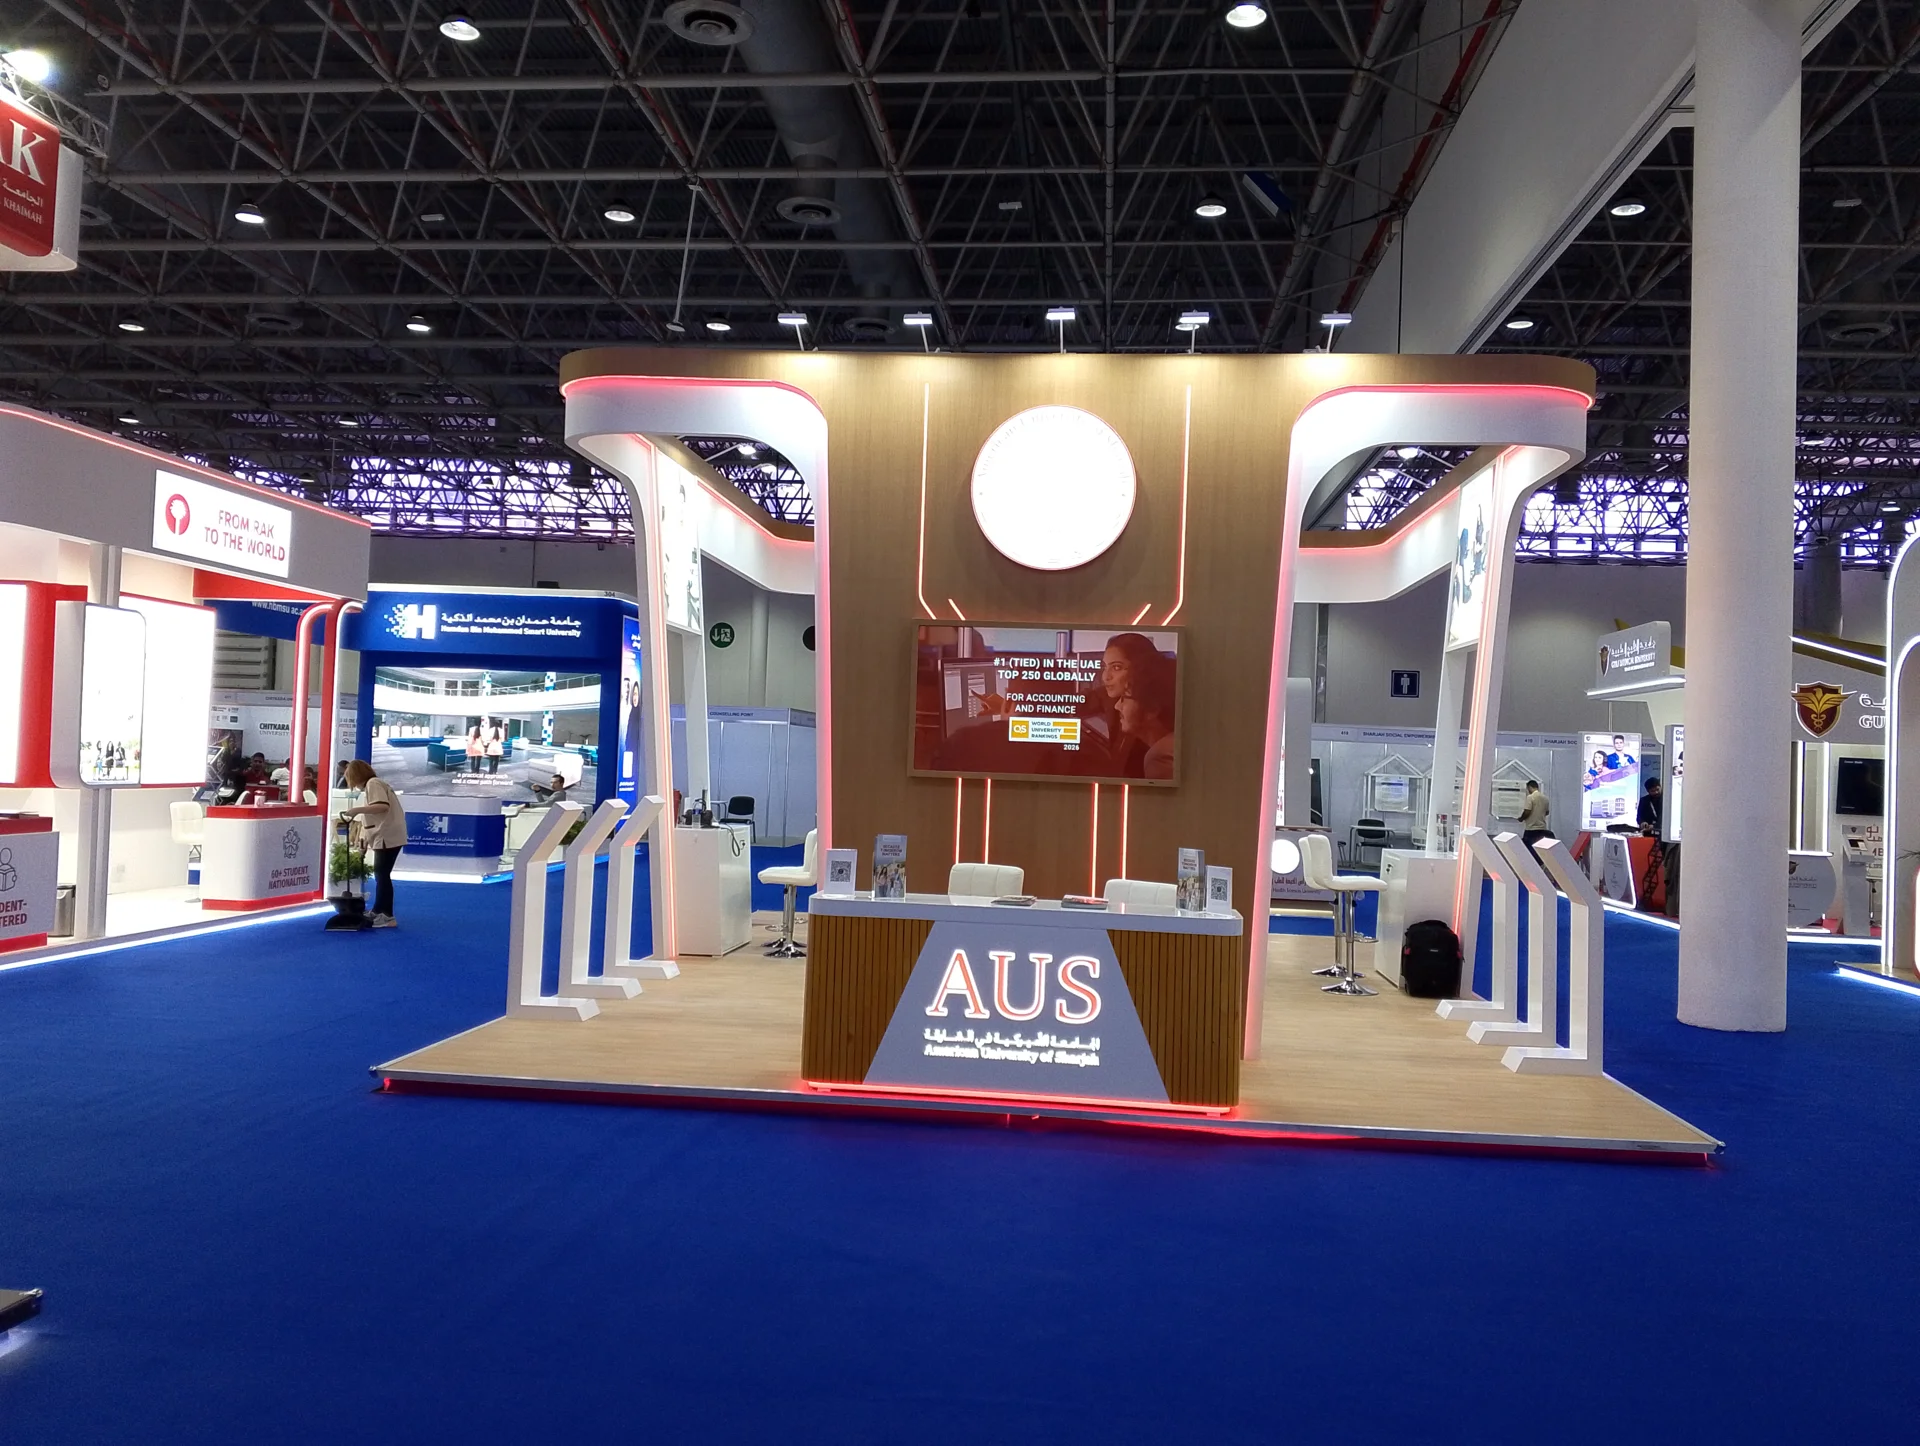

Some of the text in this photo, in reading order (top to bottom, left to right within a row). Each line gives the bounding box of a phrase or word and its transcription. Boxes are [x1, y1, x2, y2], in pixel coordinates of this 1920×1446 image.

[0, 118, 46, 186] K
[3, 196, 42, 224] KHAIMAH
[219, 510, 275, 539] FROM RAK
[205, 527, 286, 562] TO THE WORLD
[441, 612, 581, 628] جامعة حمدان بن محمد الذكية
[546, 629, 581, 638] University
[994, 657, 1101, 669] #1 (TIED) IN THE UAE
[997, 670, 1096, 682] TOP 250 GLOBALLY
[1006, 693, 1086, 703] FOR ACCOUNTING
[1014, 704, 1076, 714] AND FINANCE
[259, 722, 290, 731] CHITKARA
[1013, 725, 1027, 734] QS
[271, 865, 309, 879] 60+ STUDENT
[268, 875, 310, 889] NATIONALITIES
[925, 949, 1101, 1024] AUS
[974, 1031, 993, 1049] في
[923, 1043, 1100, 1067] American University of Sharjah
